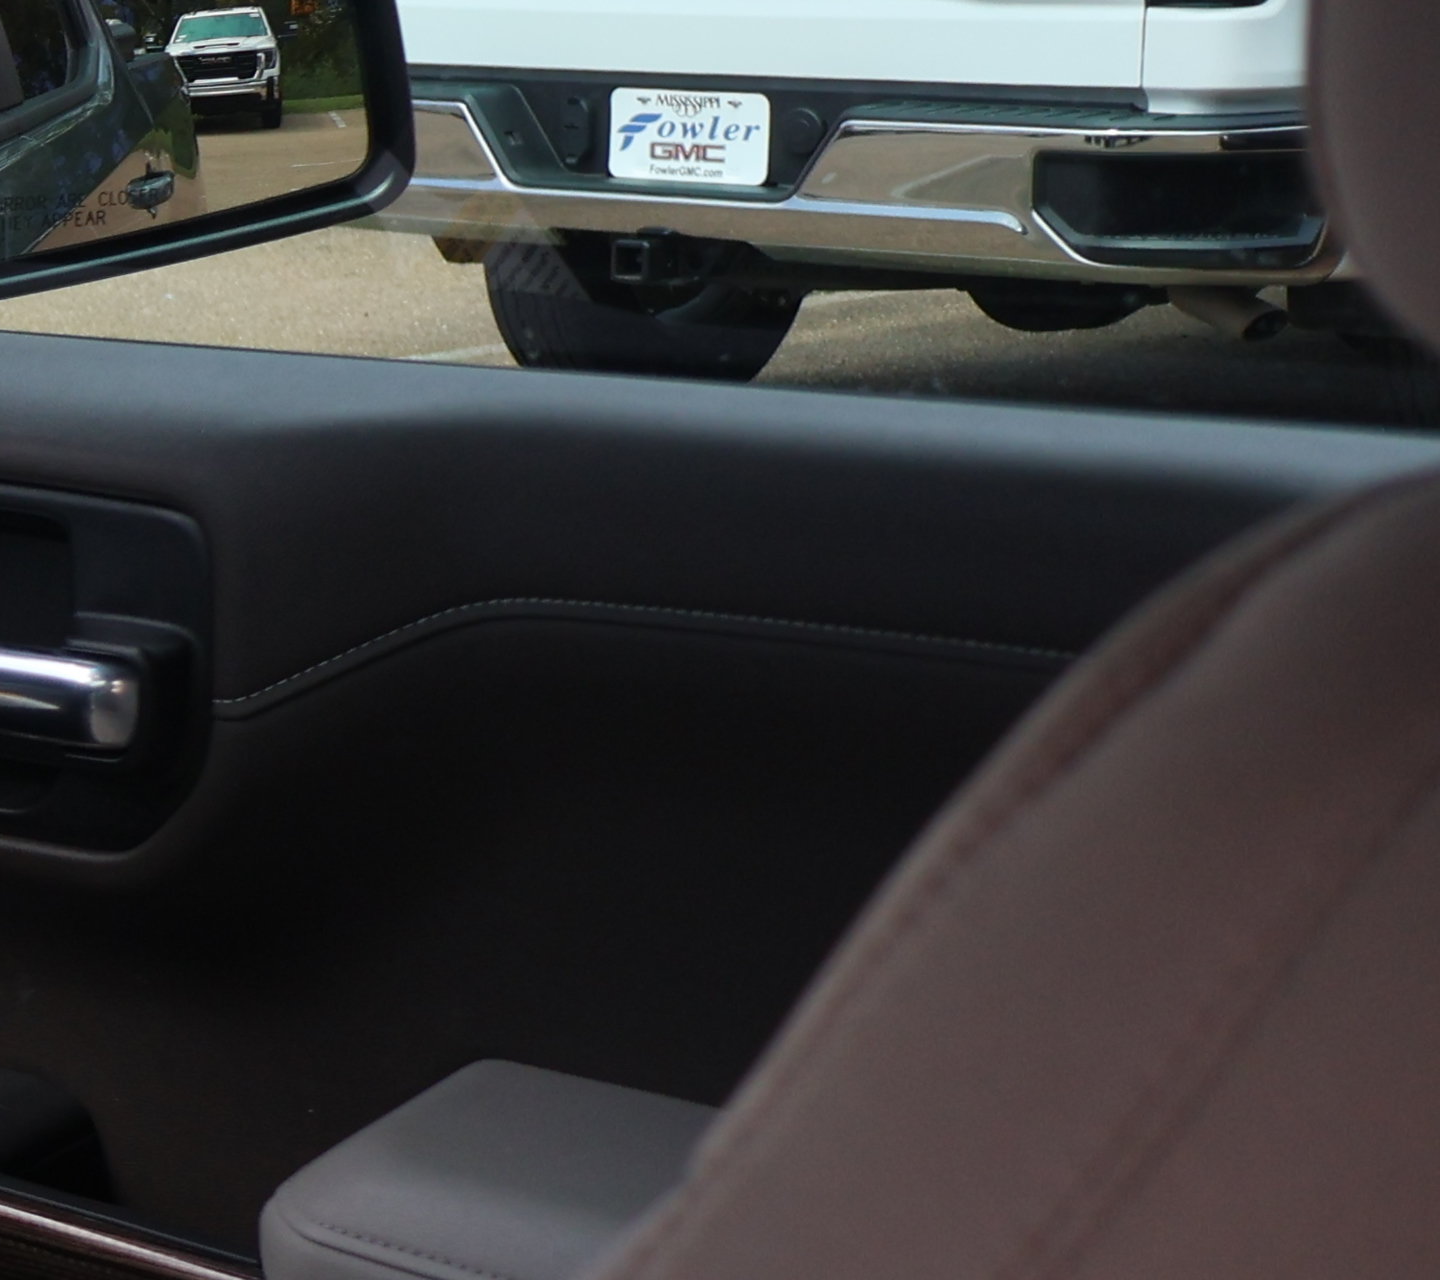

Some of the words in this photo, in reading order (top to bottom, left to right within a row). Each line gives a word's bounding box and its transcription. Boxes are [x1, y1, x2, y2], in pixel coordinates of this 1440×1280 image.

[617, 113, 760, 151] Fowler
[650, 142, 726, 163] GMC
[649, 164, 723, 178] FowlerGMC.com
[56, 193, 86, 209] ARE
[42, 210, 107, 229] APPEAR
